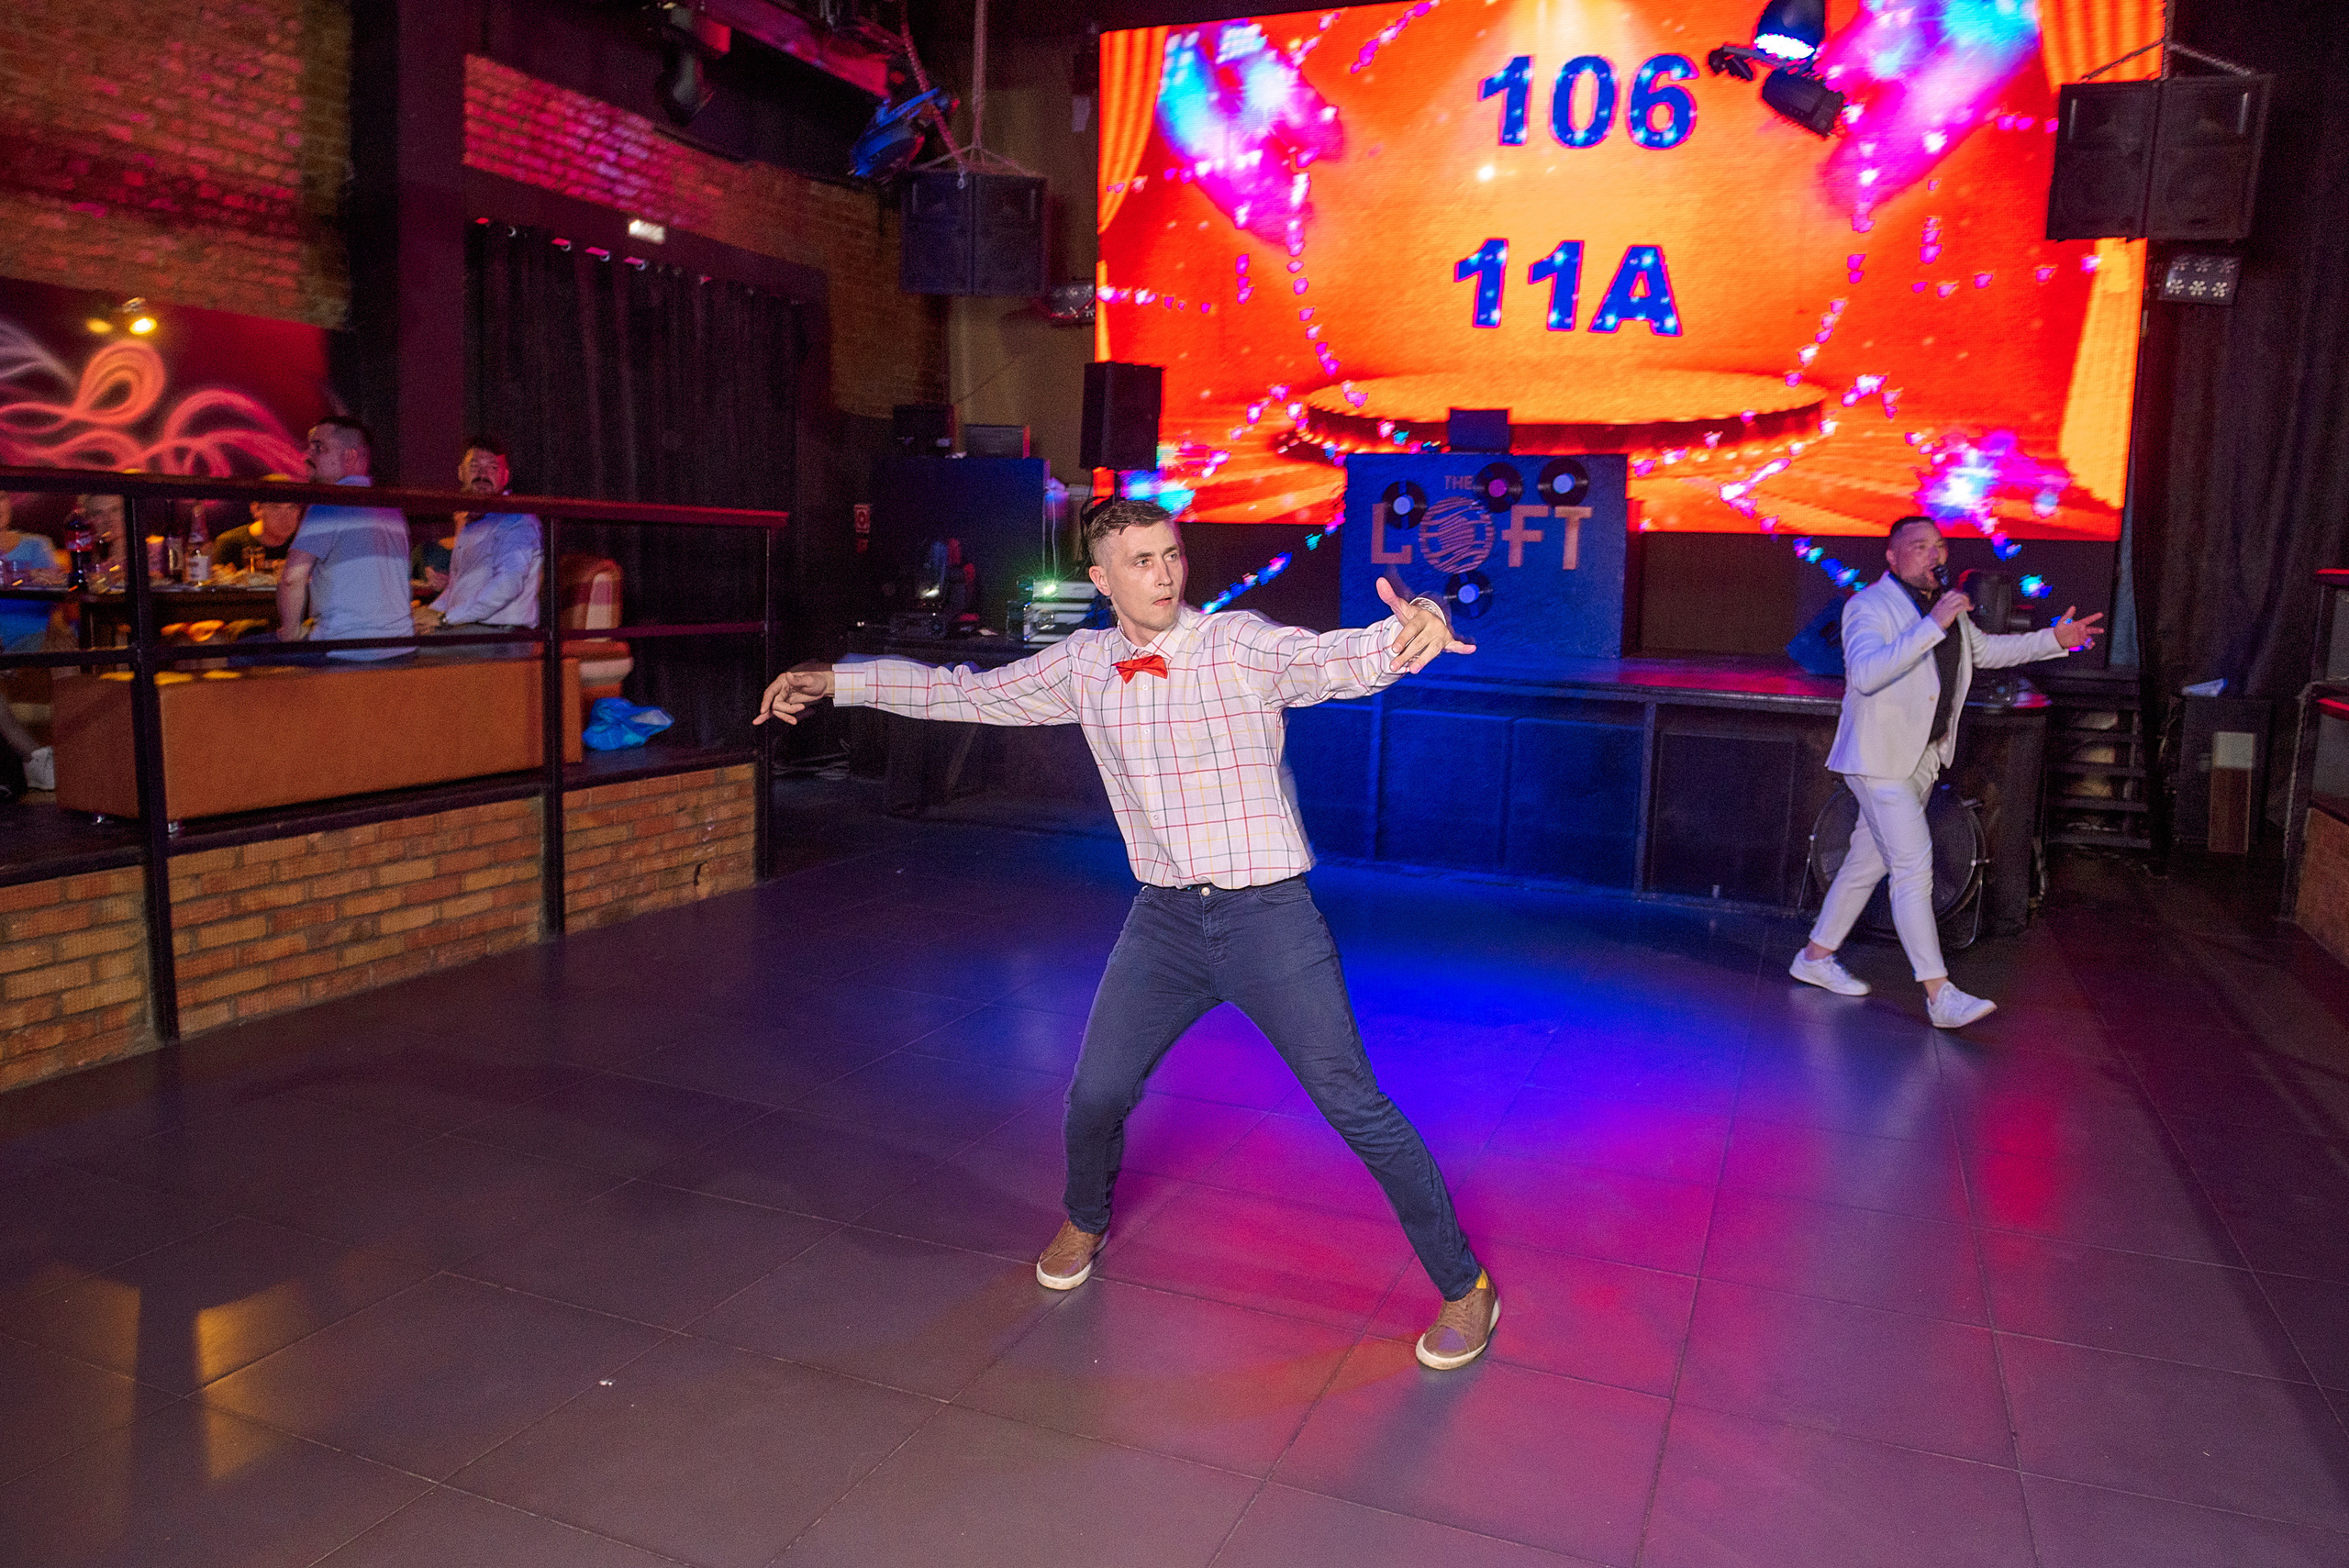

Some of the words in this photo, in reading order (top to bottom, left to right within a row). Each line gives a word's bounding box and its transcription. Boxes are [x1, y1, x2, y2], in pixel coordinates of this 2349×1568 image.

[1476, 53, 1700, 150] 106
[1445, 475, 1474, 490] THE
[1370, 497, 1593, 574] LOFT
